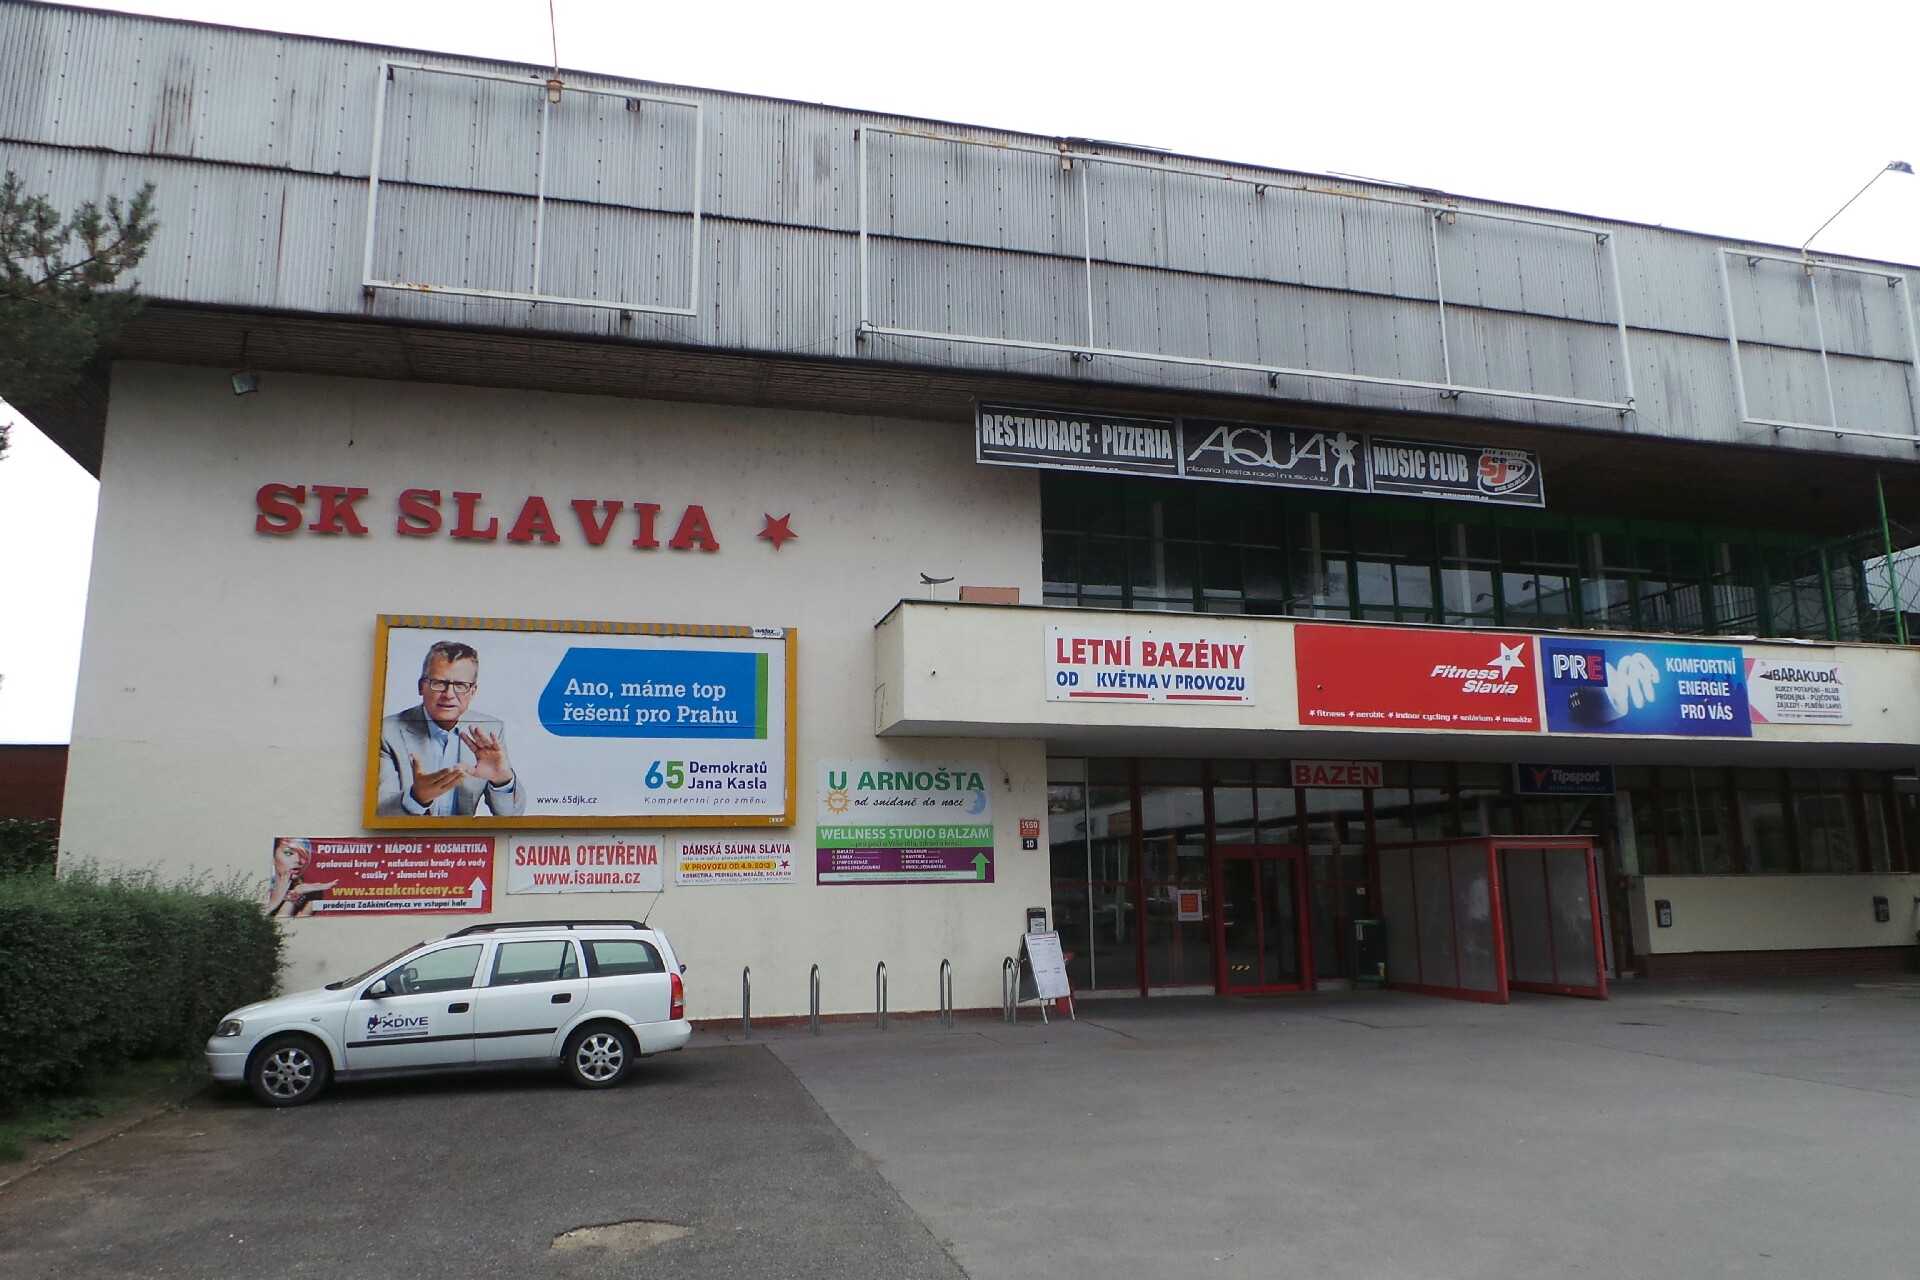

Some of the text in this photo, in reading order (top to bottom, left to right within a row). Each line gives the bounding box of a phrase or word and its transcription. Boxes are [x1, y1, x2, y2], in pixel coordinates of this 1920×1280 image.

[982, 413, 1174, 460] RESTAURACE PIZZERIA
[1187, 426, 1327, 472] AQUA
[1373, 446, 1469, 482] MUSIC CLUB
[254, 483, 721, 551] SK SLAVIA
[1056, 635, 1245, 670] LETNÍ BAZÉNY
[1430, 664, 1500, 680] Fitness
[1552, 654, 1604, 680] PRE
[1665, 657, 1737, 674] KOMFORTNÍ
[1056, 669, 1245, 691] OD KVĚTNA V PROVOZU
[1773, 667, 1838, 684] BARAKUDA
[564, 678, 726, 702] Ano, máme top
[1462, 679, 1519, 694] Slavia
[1678, 680, 1731, 696] ENERGIE
[1776, 693, 1805, 701] PRODEJNA
[563, 703, 738, 726] řešení pro Prahu
[1316, 709, 1346, 718] fitness
[1356, 710, 1385, 719] aerobic
[1395, 711, 1420, 720] indoor
[1422, 712, 1451, 722] cycling
[1680, 702, 1734, 721] PRO VÁS
[644, 760, 685, 790] 65
[689, 760, 768, 774] Demokratů
[1295, 761, 1379, 785] BAZÉN
[688, 777, 768, 790] Jana Kasla
[829, 767, 985, 791] U ARNOŠTA
[1551, 769, 1601, 784] Tipsport
[536, 795, 598, 805] www.65djk.cz
[644, 796, 768, 805] Kompetentní pro změnu
[854, 796, 964, 806] od snídaně do noci
[821, 828, 989, 840] WELLNESS STUDIO BALZAM
[317, 842, 488, 854] POTRAVINY NÁPOJE KOSMETIKA
[682, 842, 791, 855] DÁMSKÁ SAUNA SLAVIA
[1026, 840, 1034, 848] 10
[515, 840, 658, 867] SAUNA OTEVŘENA
[316, 859, 353, 868] opalovací
[388, 859, 429, 868] nafukovací
[457, 858, 466, 867] do
[468, 858, 486, 868] vody
[533, 869, 641, 885] www.isauna.cz
[332, 883, 465, 897] www.zaakcniceny.cz
[323, 902, 356, 910] prodejna
[424, 900, 450, 908] vstupní
